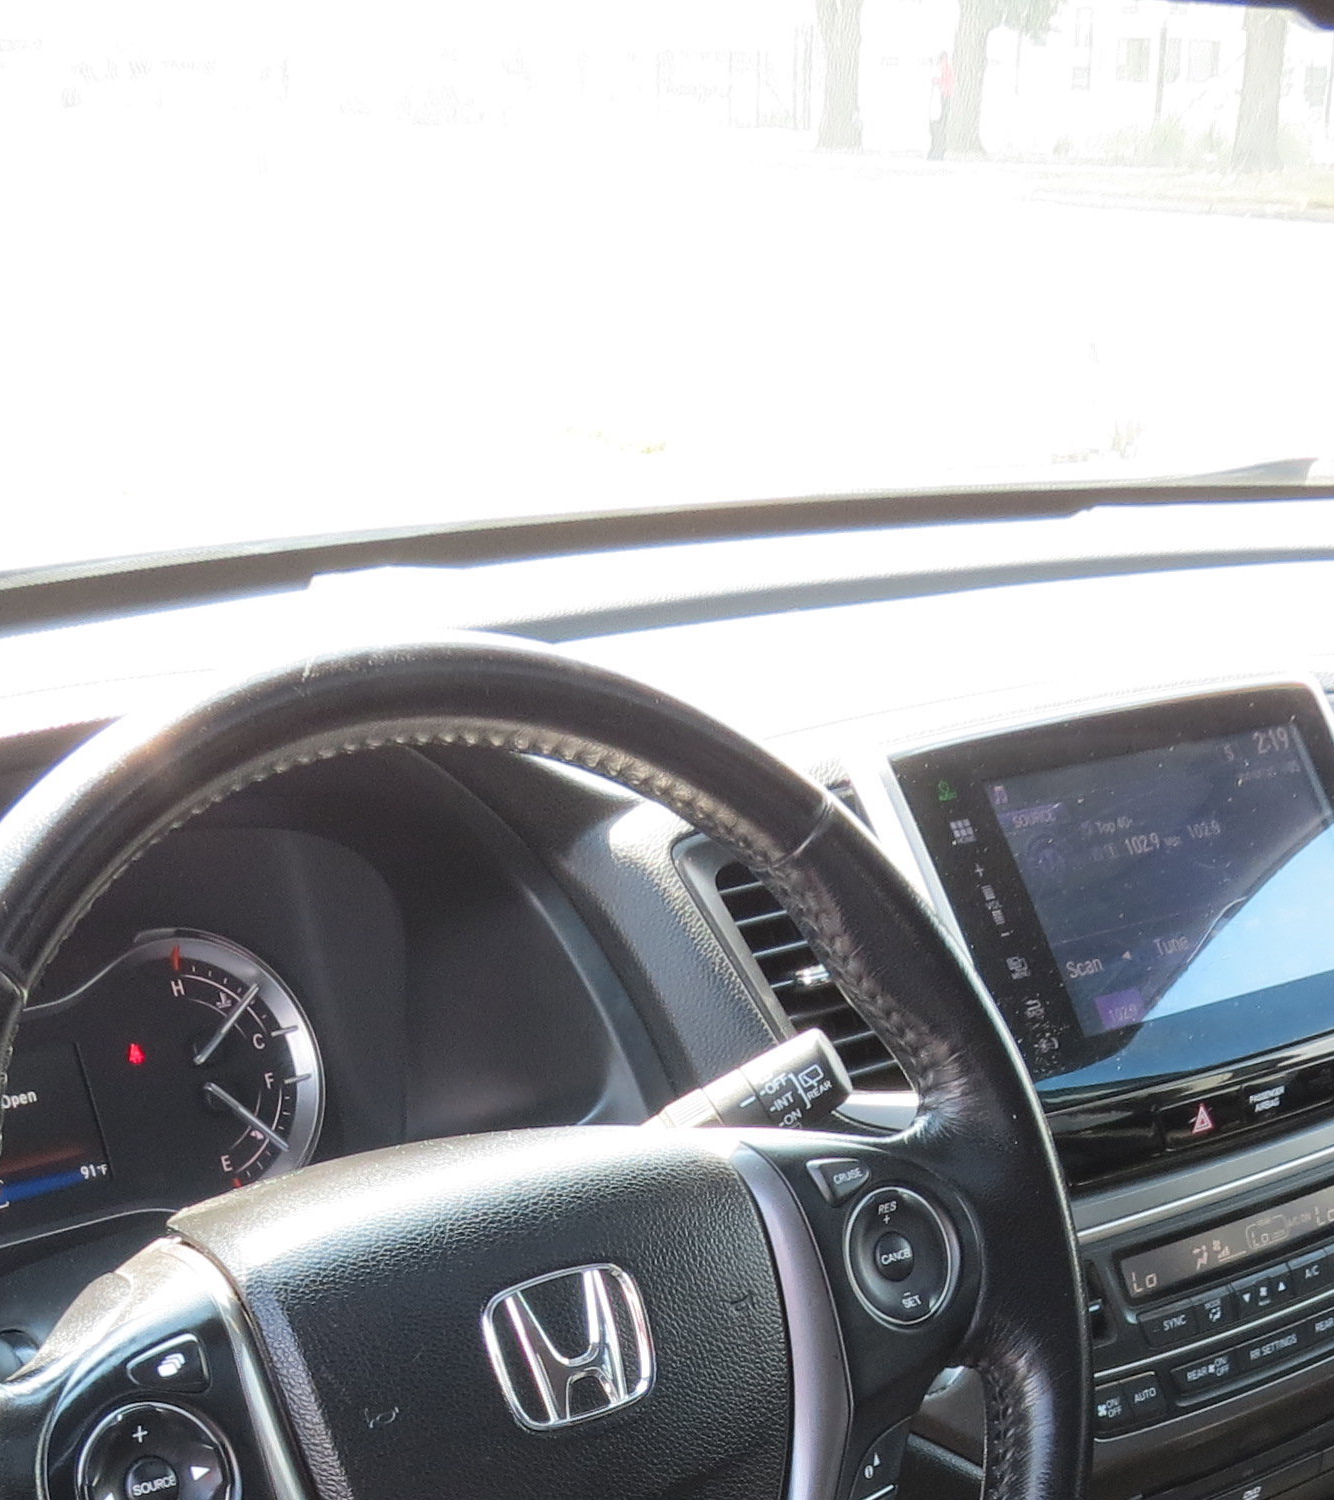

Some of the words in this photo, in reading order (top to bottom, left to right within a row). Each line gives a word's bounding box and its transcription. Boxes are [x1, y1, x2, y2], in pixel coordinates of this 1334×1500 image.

[1253, 728, 1289, 755] 2:19
[1153, 934, 1190, 956] Tune
[1066, 957, 1104, 979] Scan
[170, 979, 186, 998] H
[252, 1033, 266, 1050] C
[264, 1072, 275, 1090] F
[807, 1080, 833, 1101] REAR
[774, 1091, 794, 1111] INT
[783, 1108, 803, 1126] ON
[220, 1154, 233, 1173] E
[833, 1167, 864, 1185] CRUISE
[878, 1200, 897, 1216] RES
[902, 1295, 922, 1309] SET
[1163, 1313, 1188, 1332] SYNC
[1314, 1318, 1334, 1333] REAR
[1262, 1333, 1298, 1357] SETTINGS
[1187, 1366, 1208, 1382] REAR
[1134, 1386, 1157, 1403] AUTO
[1107, 1405, 1123, 1419] OFF
[131, 1474, 177, 1497] SOURCE
